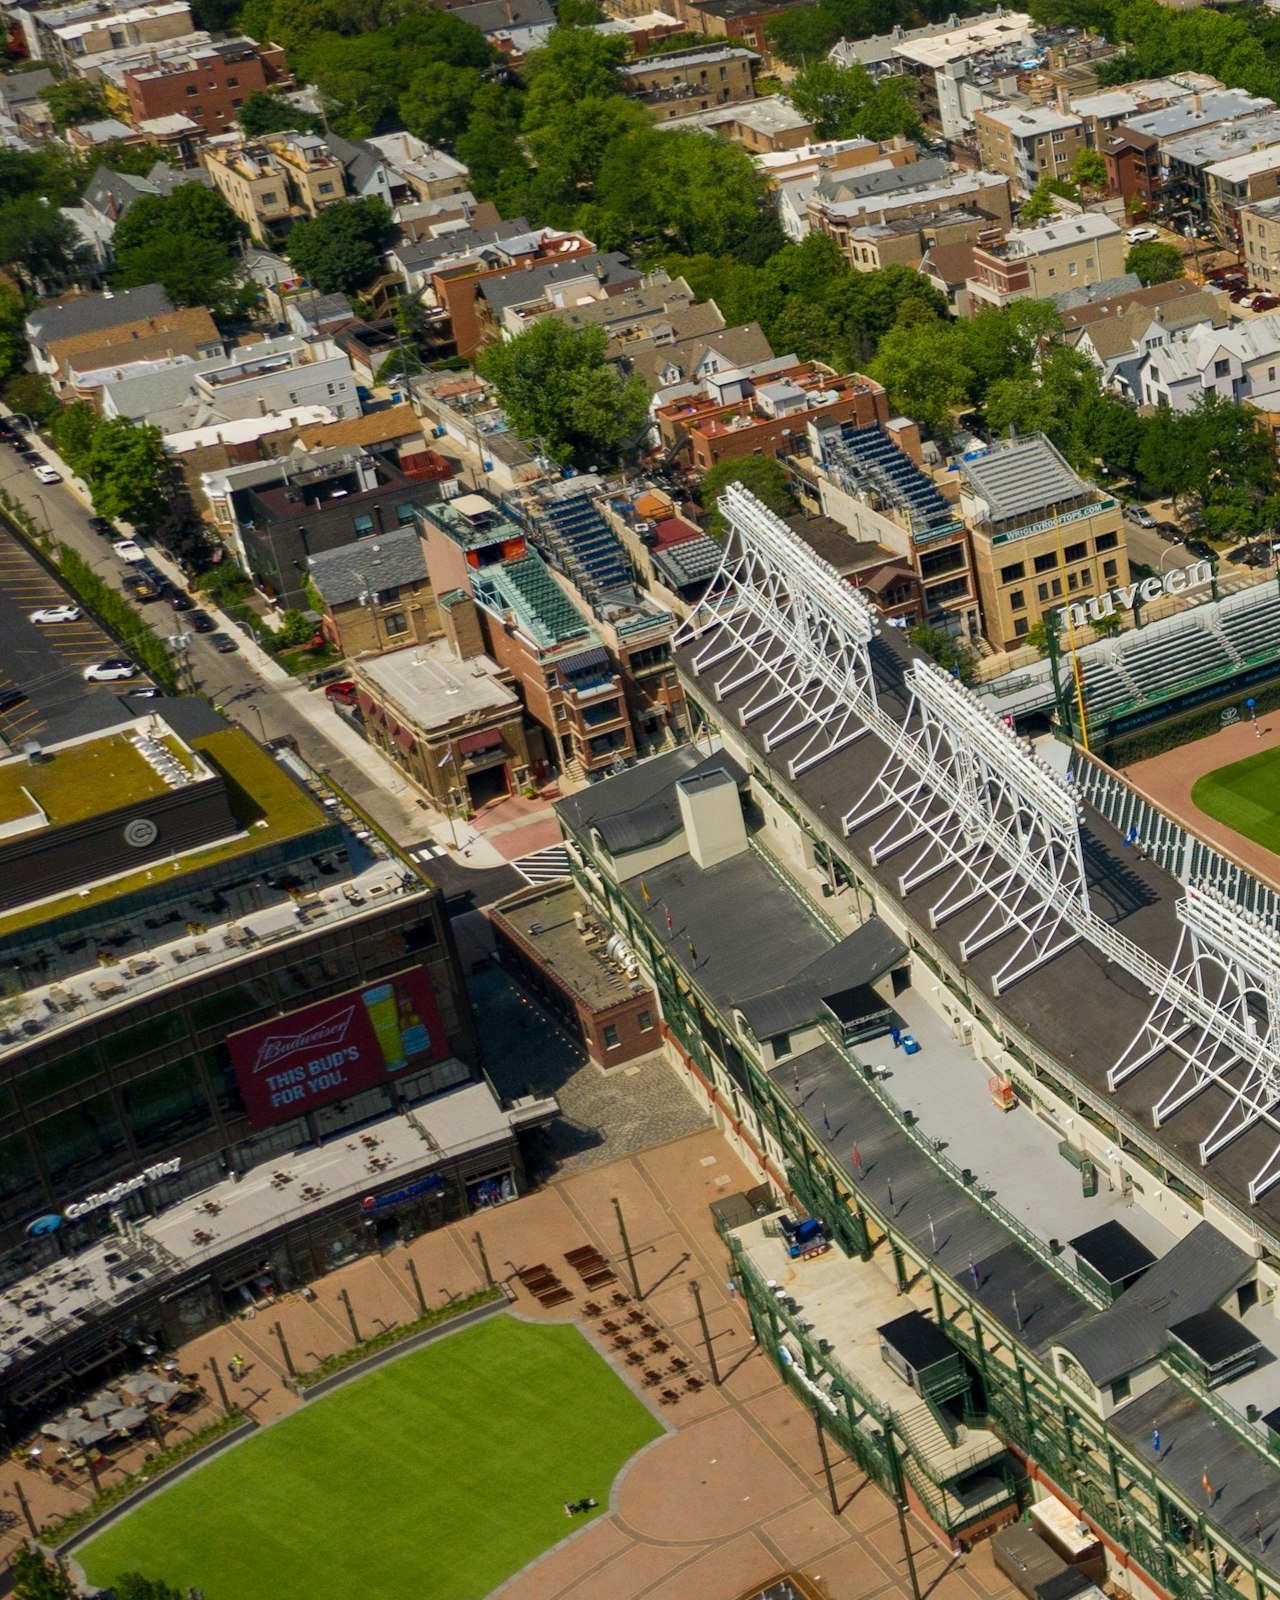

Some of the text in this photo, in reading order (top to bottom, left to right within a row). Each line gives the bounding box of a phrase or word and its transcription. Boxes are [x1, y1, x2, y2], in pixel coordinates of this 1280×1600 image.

[1006, 504, 1102, 540] WRIGLEYROOFTOPS.COM
[1056, 559, 1216, 630] nuveen
[1220, 716, 1241, 727] TOYOTA
[257, 1021, 346, 1062] Budweiser
[265, 1046, 360, 1091] THIS BUD'S
[271, 1070, 349, 1107] FOR YOU.
[65, 1157, 181, 1220] Gallagher Way
